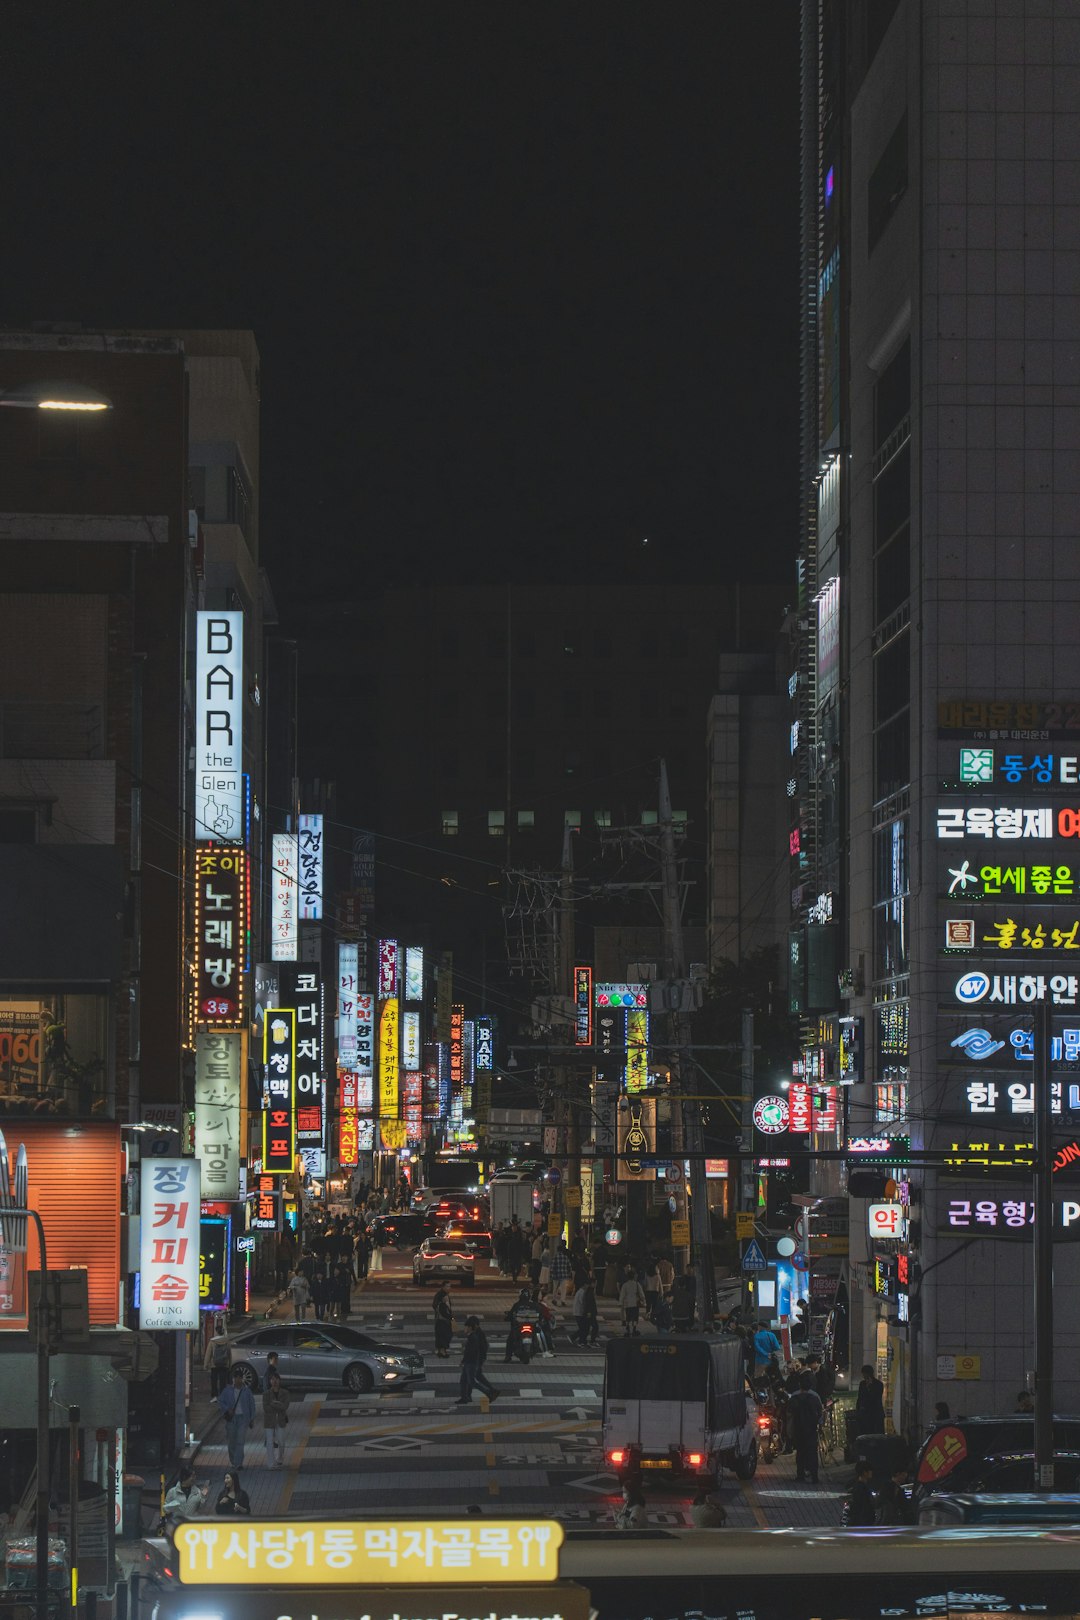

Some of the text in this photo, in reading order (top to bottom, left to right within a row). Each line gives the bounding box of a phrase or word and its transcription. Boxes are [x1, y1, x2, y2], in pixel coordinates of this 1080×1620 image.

[206, 619, 233, 746] BAR
[205, 753, 233, 766] the
[1000, 754, 1080, 783] 동성 E
[202, 776, 236, 790] Glen
[937, 807, 1053, 838] 근육형제
[199, 856, 239, 875] 조이
[300, 829, 322, 905] 정담은
[980, 866, 1074, 894] 연세 좋은
[277, 858, 293, 938] 방배양조장
[204, 883, 236, 989] 노래방
[340, 975, 356, 1022] 나무
[989, 975, 1079, 1004] 새하얀
[207, 1000, 229, 1014] 3층
[295, 974, 321, 1095] 코다차야
[478, 1028, 491, 1067] BAR
[144, 1109, 177, 1122] 라이브
[270, 1053, 289, 1157] 청맥 호프
[340, 1107, 357, 1163] 정육식당
[874, 1209, 898, 1233] 약
[948, 1200, 1053, 1227] 근육형
[239, 1239, 253, 1248] Cass
[145, 1318, 194, 1328] Coffee shop
[157, 1306, 182, 1315] JUNG
[223, 1527, 513, 1568] 사당1동 먹자골목
